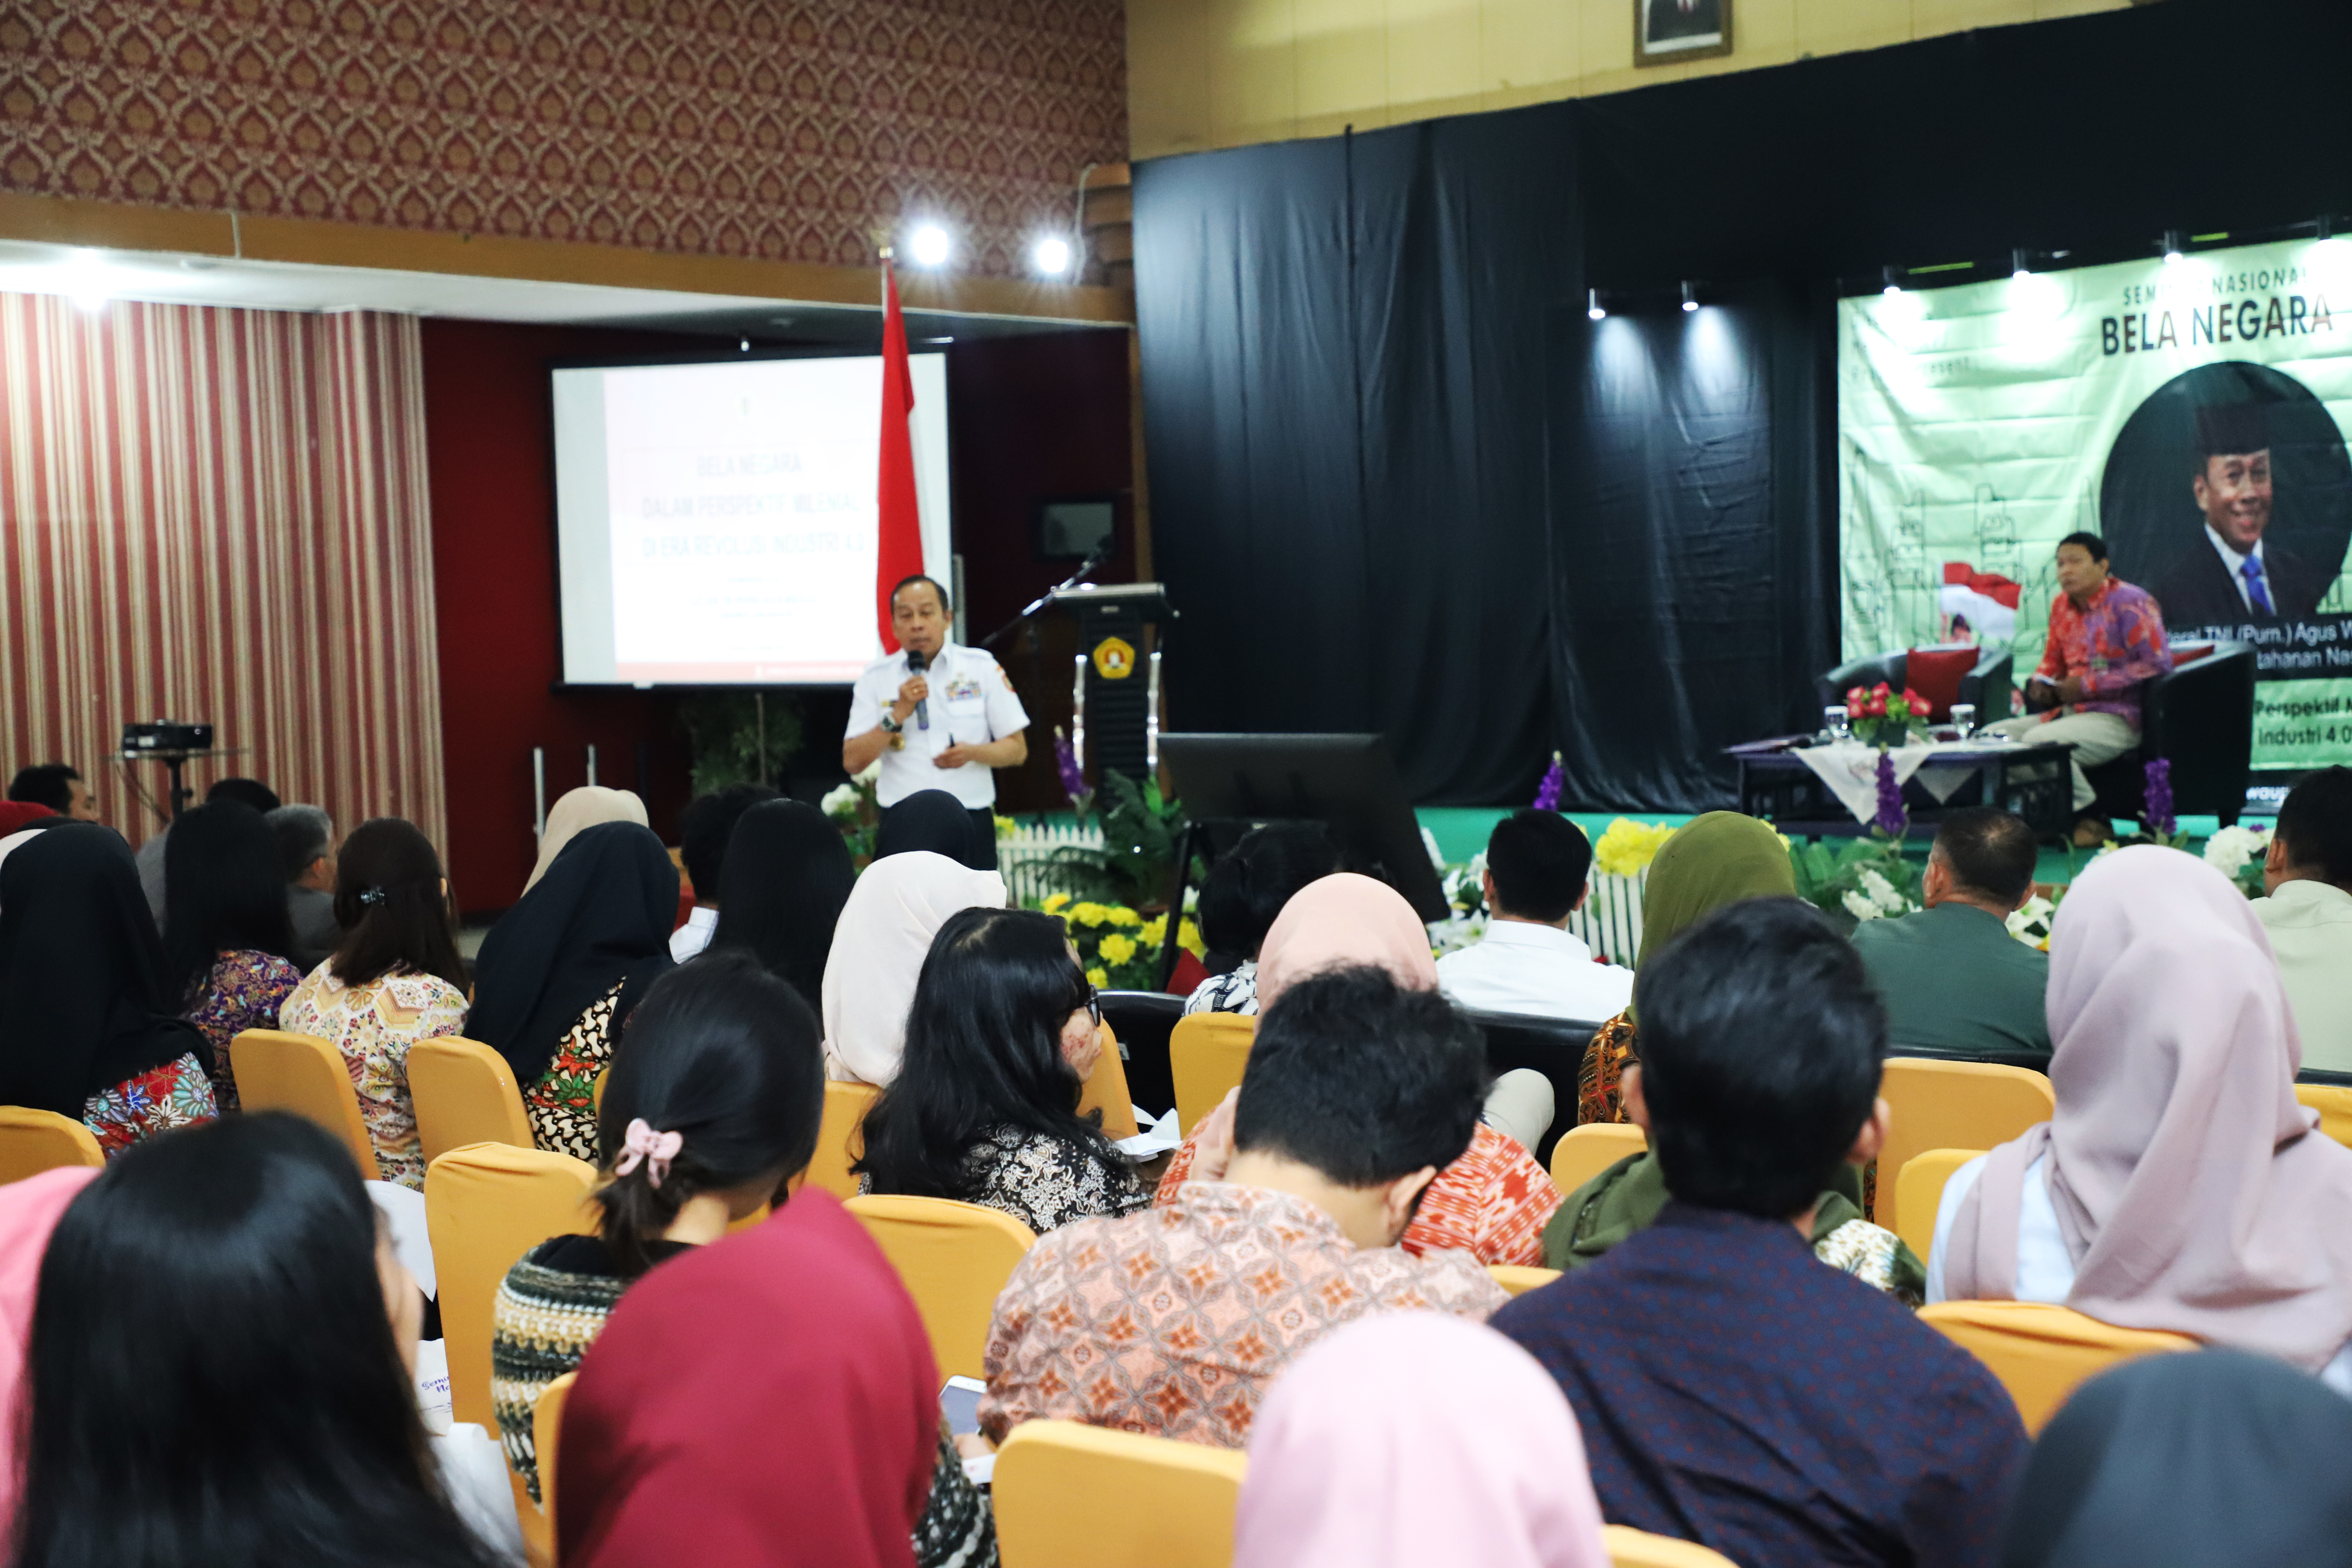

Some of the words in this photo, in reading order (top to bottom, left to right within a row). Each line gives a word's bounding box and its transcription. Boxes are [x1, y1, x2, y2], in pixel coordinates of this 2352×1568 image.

[2123, 280, 2204, 306] SEMI
[2101, 310, 2178, 355] BELA
[2193, 293, 2333, 345] NEGARA
[697, 455, 734, 477] BELA
[740, 452, 803, 475] NEGARA
[642, 496, 694, 518] DALAM
[697, 493, 787, 517] PERSPEKTIF
[792, 492, 860, 513] MILENIAL
[642, 536, 657, 558] DI
[661, 535, 691, 558] ERA
[694, 534, 766, 556] REVOLUSI
[771, 532, 839, 554] INDUSTRI
[2294, 621, 2337, 647] Agus
[2326, 646, 2352, 667] Na
[2253, 697, 2339, 718] Perspektif
[2259, 726, 2321, 746] Industri
